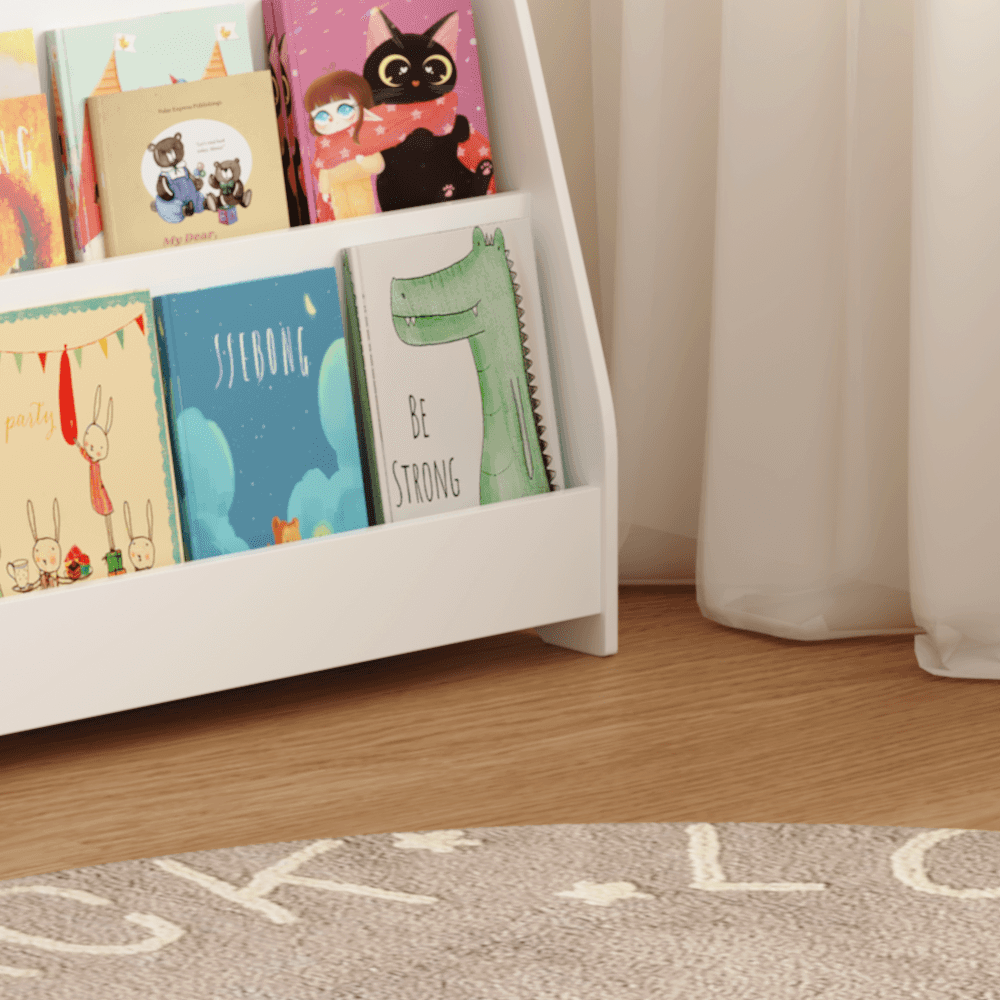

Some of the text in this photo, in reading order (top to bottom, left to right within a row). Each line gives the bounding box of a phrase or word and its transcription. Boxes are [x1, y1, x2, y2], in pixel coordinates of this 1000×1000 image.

[163, 237, 182, 247] My
[214, 323, 309, 389] SSEBONG
[3, 401, 57, 444] party
[409, 394, 430, 439] BE
[392, 457, 460, 508] STRONG
